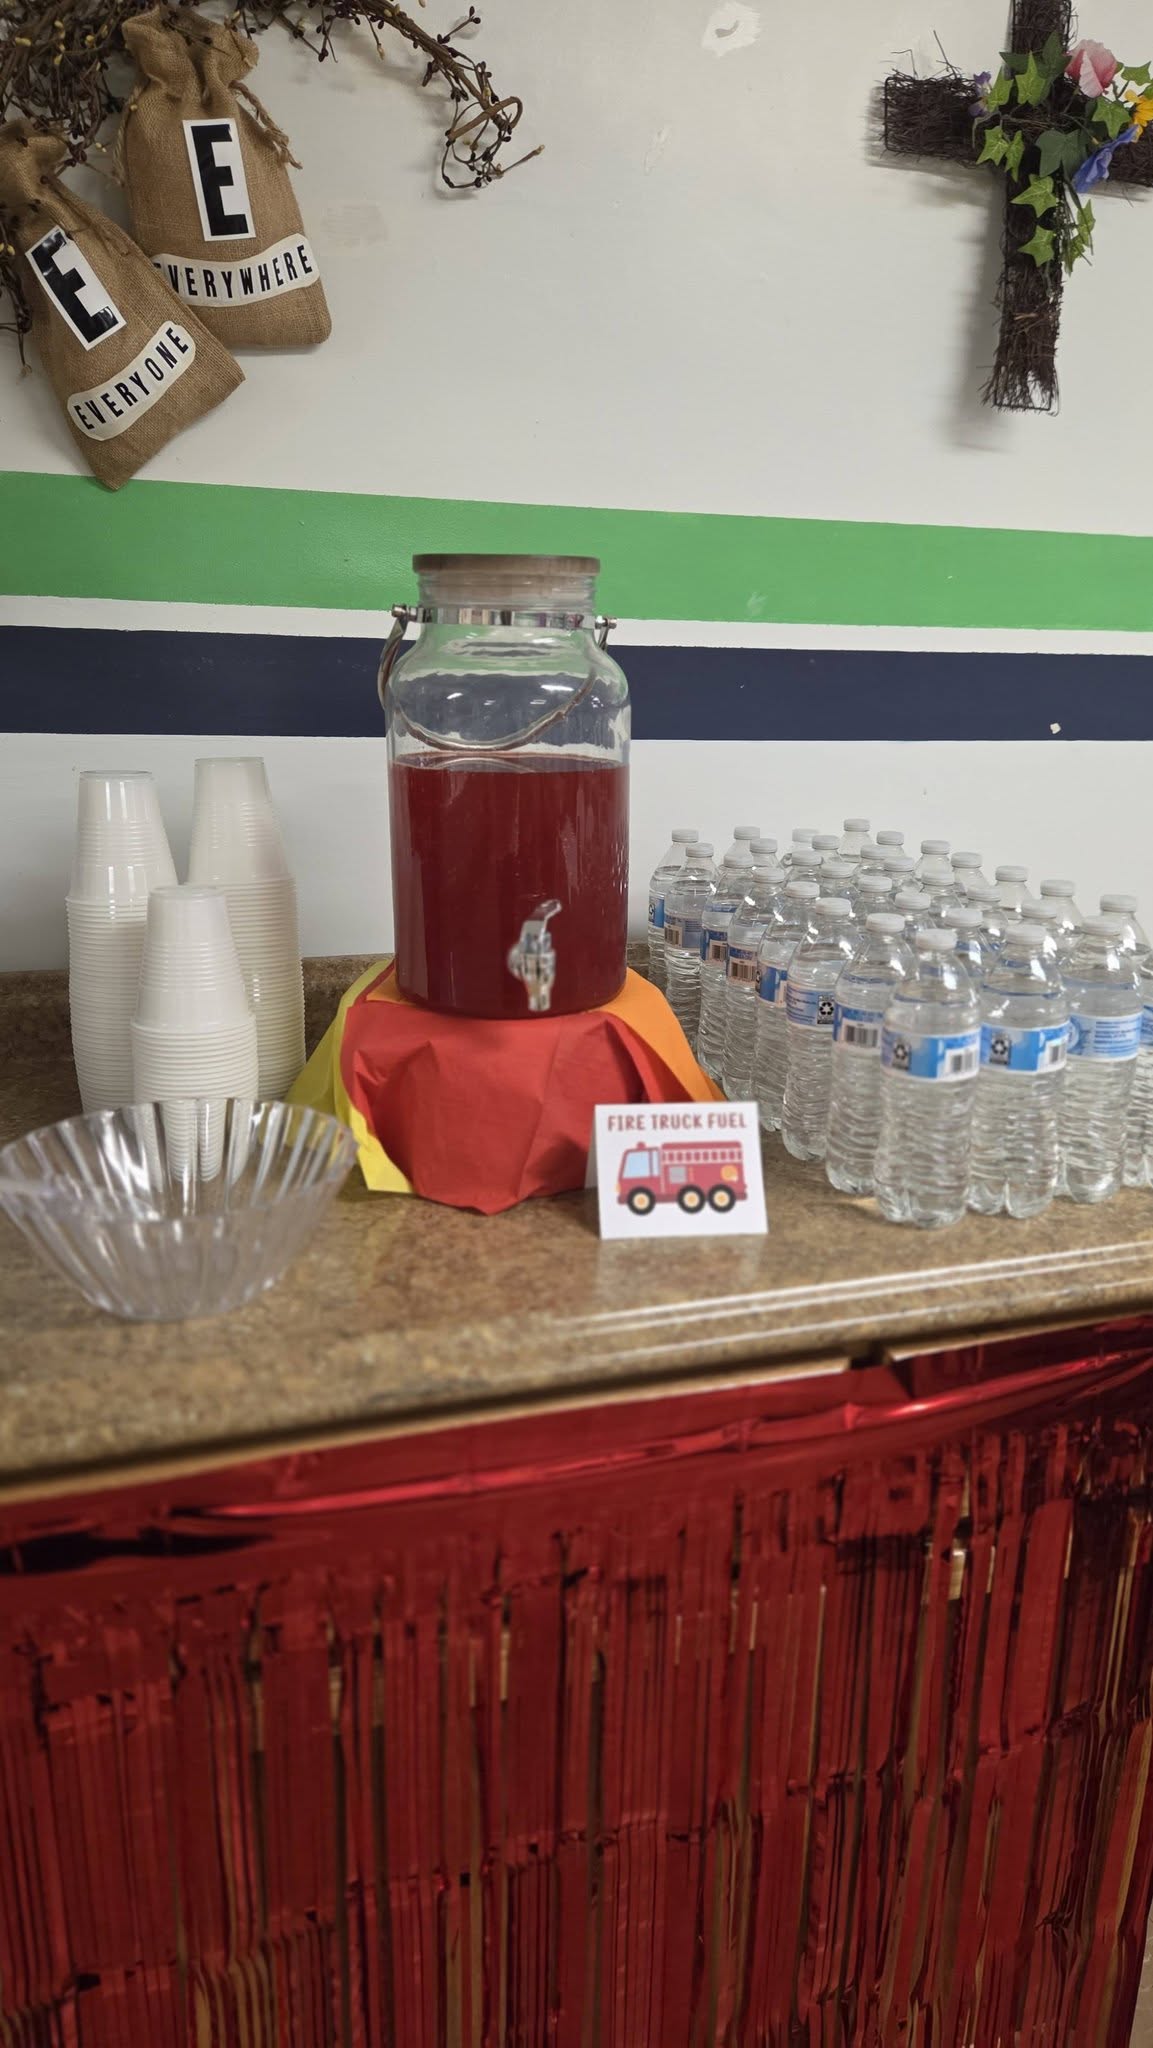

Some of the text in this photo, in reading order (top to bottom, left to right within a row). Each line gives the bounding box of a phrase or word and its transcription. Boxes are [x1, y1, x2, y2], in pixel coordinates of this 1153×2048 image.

[190, 123, 250, 236] E
[30, 229, 119, 344] E
[153, 244, 313, 298] VERYWHERE
[73, 326, 190, 431] EVERYONE
[607, 1112, 747, 1132] FIRE TRUCK FUEL
